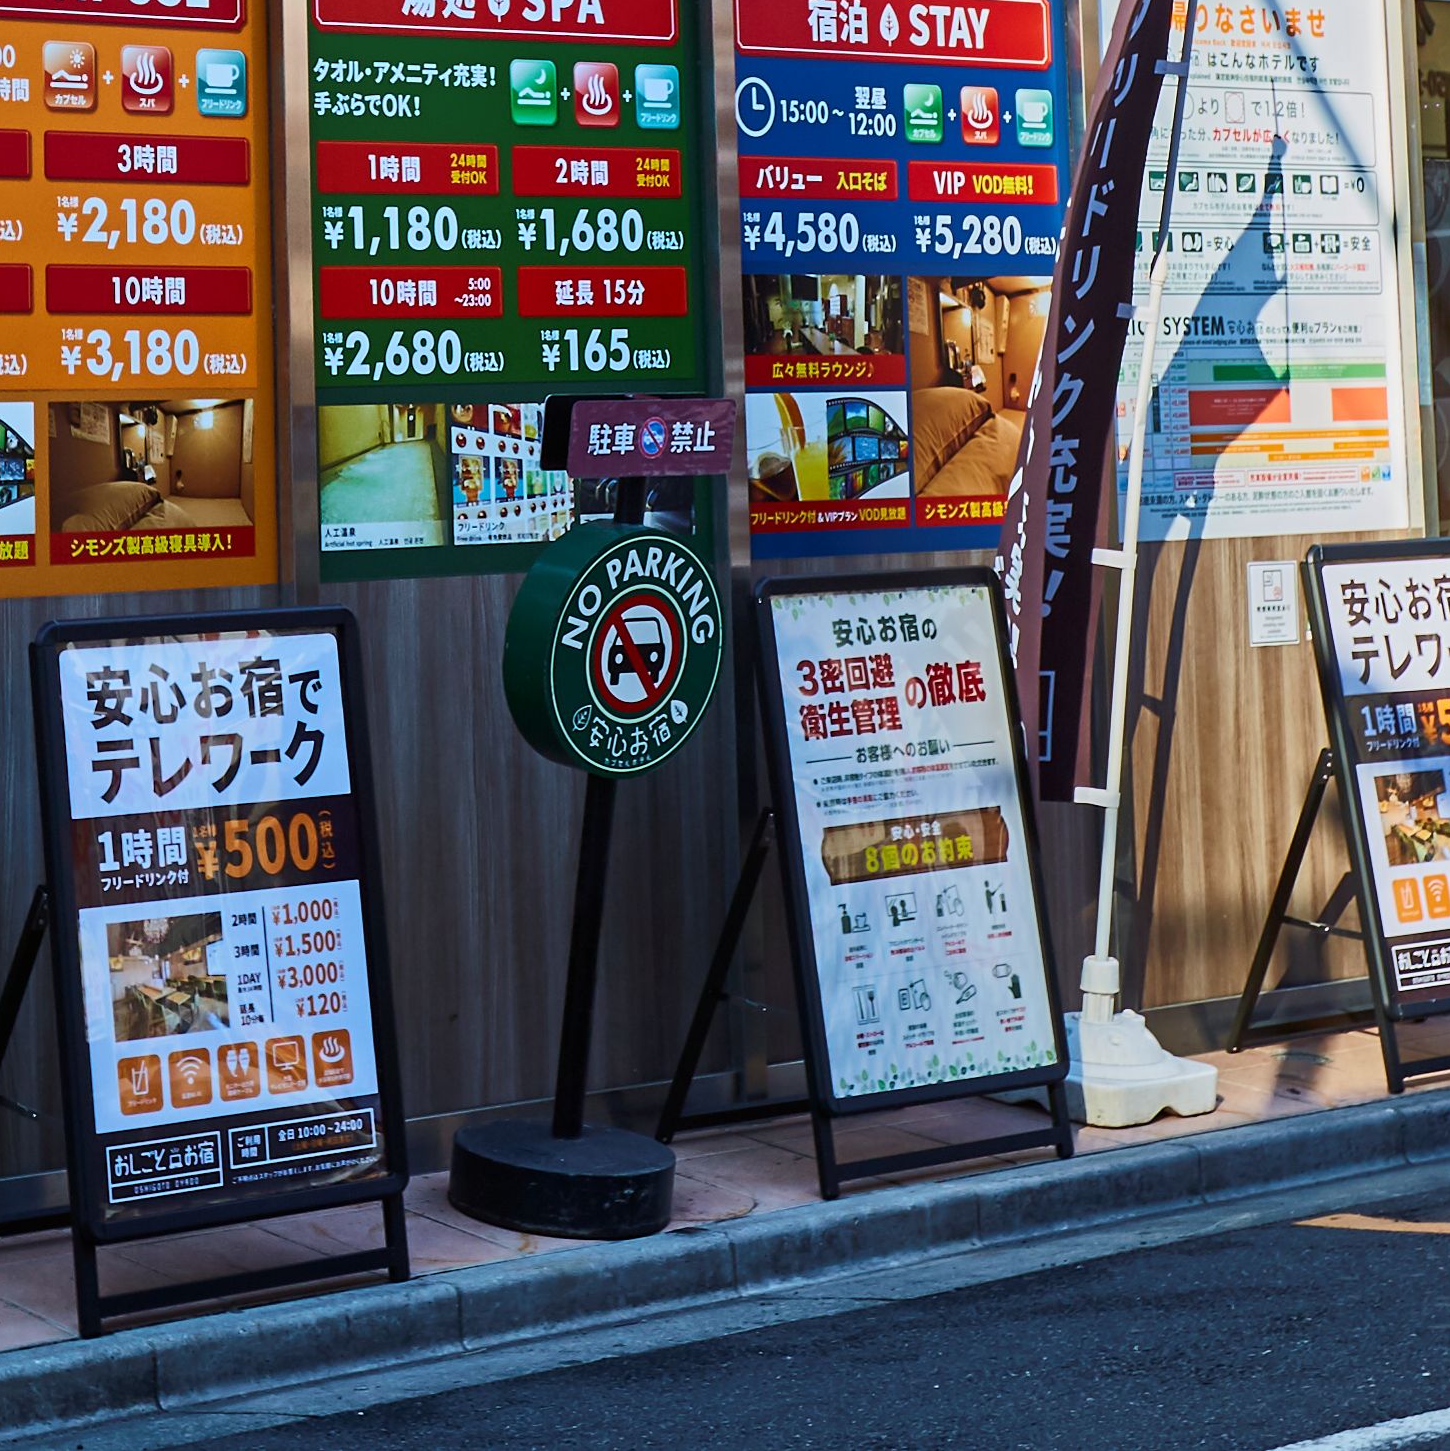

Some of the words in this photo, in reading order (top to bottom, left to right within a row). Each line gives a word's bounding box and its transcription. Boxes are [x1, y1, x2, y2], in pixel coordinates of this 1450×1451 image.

[909, 3, 990, 50] STAY
[139, 98, 156, 109] スパ
[314, 91, 421, 118] 手ぶらでOK!
[780, 99, 829, 124] 15:00
[855, 86, 887, 110] 翌昼
[849, 112, 896, 137] 12:00
[118, 144, 177, 174] 3時間
[368, 154, 421, 183] 1時間
[450, 153, 487, 168] 24時間
[555, 158, 608, 186] 2時間
[636, 157, 670, 172] 24時間
[450, 170, 487, 185] 受付OK
[636, 173, 670, 187] 受付OK
[756, 165, 822, 190] バリュー
[836, 172, 887, 191] 入口そば
[933, 170, 966, 195] VIP
[57, 197, 196, 250] ¥2,180
[324, 206, 458, 256] ¥1,180
[518, 208, 644, 256] ¥1,680
[744, 211, 859, 258] ¥4,580
[915, 215, 1022, 259] ¥5,280
[1350, 236, 1371, 251] 安全
[112, 276, 186, 307] 10時間
[370, 278, 437, 306] 10時間
[555, 280, 593, 306] 延長
[604, 279, 645, 306] 15分
[1163, 316, 1225, 336] SYSTEM
[61, 329, 200, 382] ¥3,180
[325, 330, 462, 380] ¥2,680
[541, 329, 631, 372] ¥165
[587, 423, 635, 456] 駐車
[670, 421, 716, 453] 禁止
[561, 584, 602, 650] NO
[605, 547, 715, 645] PARKING
[832, 613, 938, 648] 安心お宿の
[85, 656, 323, 730] 安心お宿で
[796, 653, 895, 696] 3密回避
[905, 660, 987, 709] の徹底
[799, 696, 902, 741] 衛生管理
[1360, 702, 1418, 737] 1時間
[589, 713, 671, 757] 安心お宿
[92, 721, 325, 804] テレワーク
[856, 738, 950, 764] お客様へのお願い
[98, 826, 187, 872] 1時間
[196, 812, 319, 880] ¥500
[101, 868, 190, 892] フリードリンク付
[232, 912, 257, 926] 2時間
[234, 944, 259, 958] 3時間
[114, 1150, 168, 1177] おしごと
[185, 1141, 214, 1166] お宿
